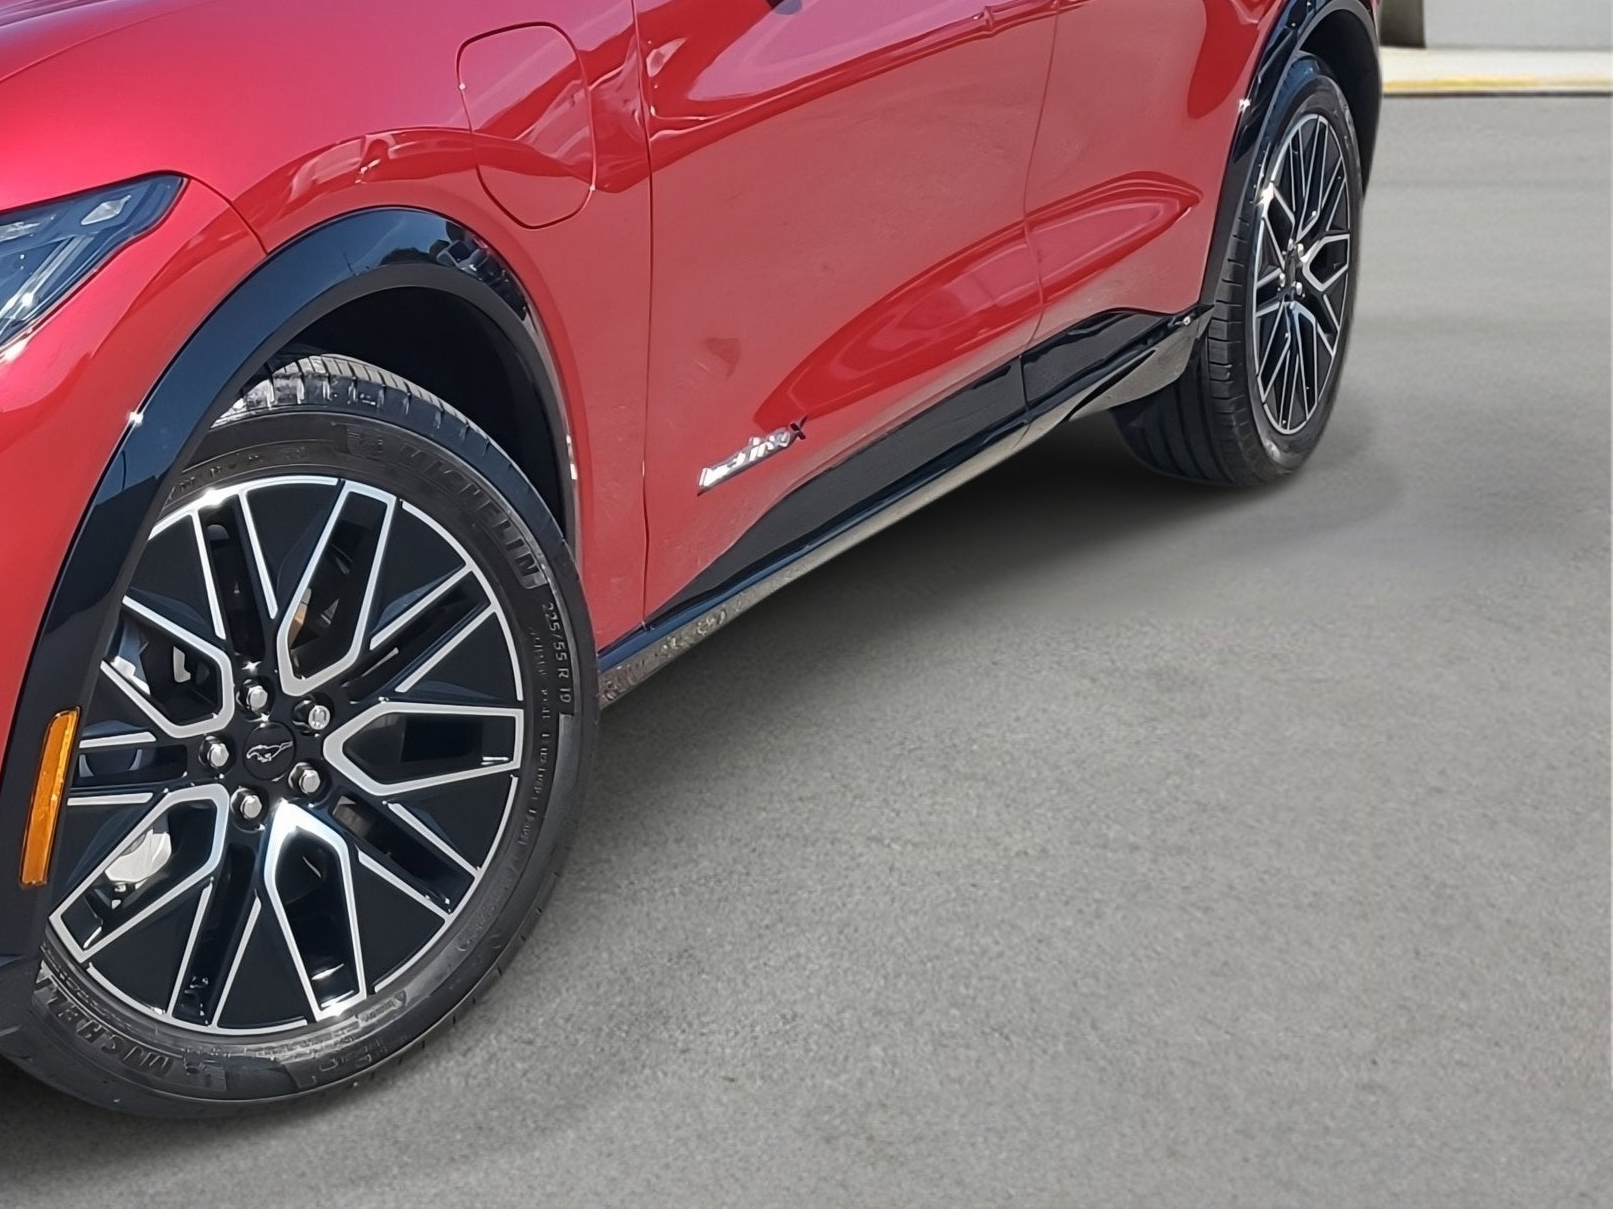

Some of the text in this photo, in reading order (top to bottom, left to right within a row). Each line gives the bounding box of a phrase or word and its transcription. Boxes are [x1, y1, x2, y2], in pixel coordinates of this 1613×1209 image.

[400, 441, 539, 578] MICHELIN
[542, 602, 567, 661] 225/55
[557, 667, 570, 679] R
